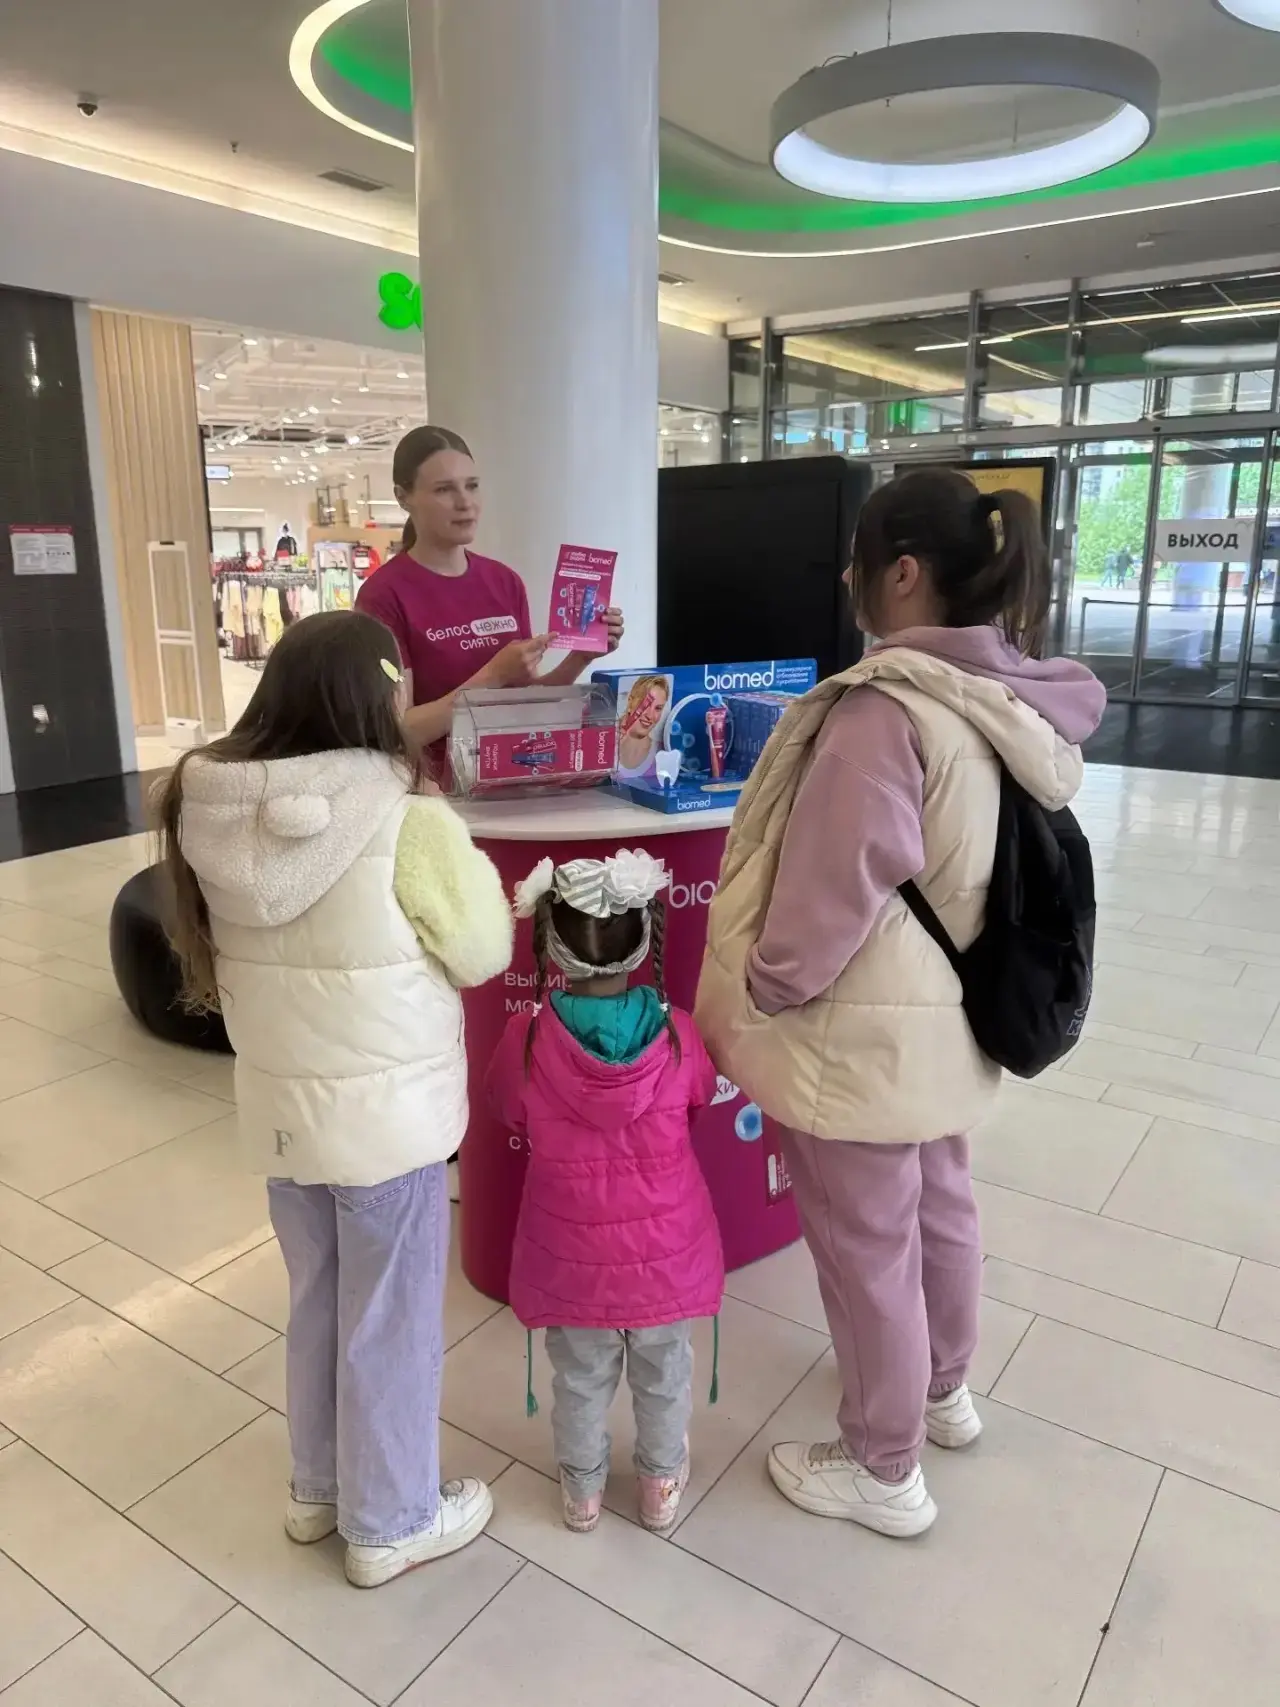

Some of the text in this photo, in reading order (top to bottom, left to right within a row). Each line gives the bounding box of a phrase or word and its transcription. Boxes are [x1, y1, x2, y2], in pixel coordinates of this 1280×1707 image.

[1167, 533, 1239, 550] ВЫХОД
[460, 636, 499, 650] сиять
[704, 660, 775, 691] biomed
[598, 731, 609, 765] biomed
[677, 795, 712, 811] biomed
[272, 1128, 293, 1157] F
